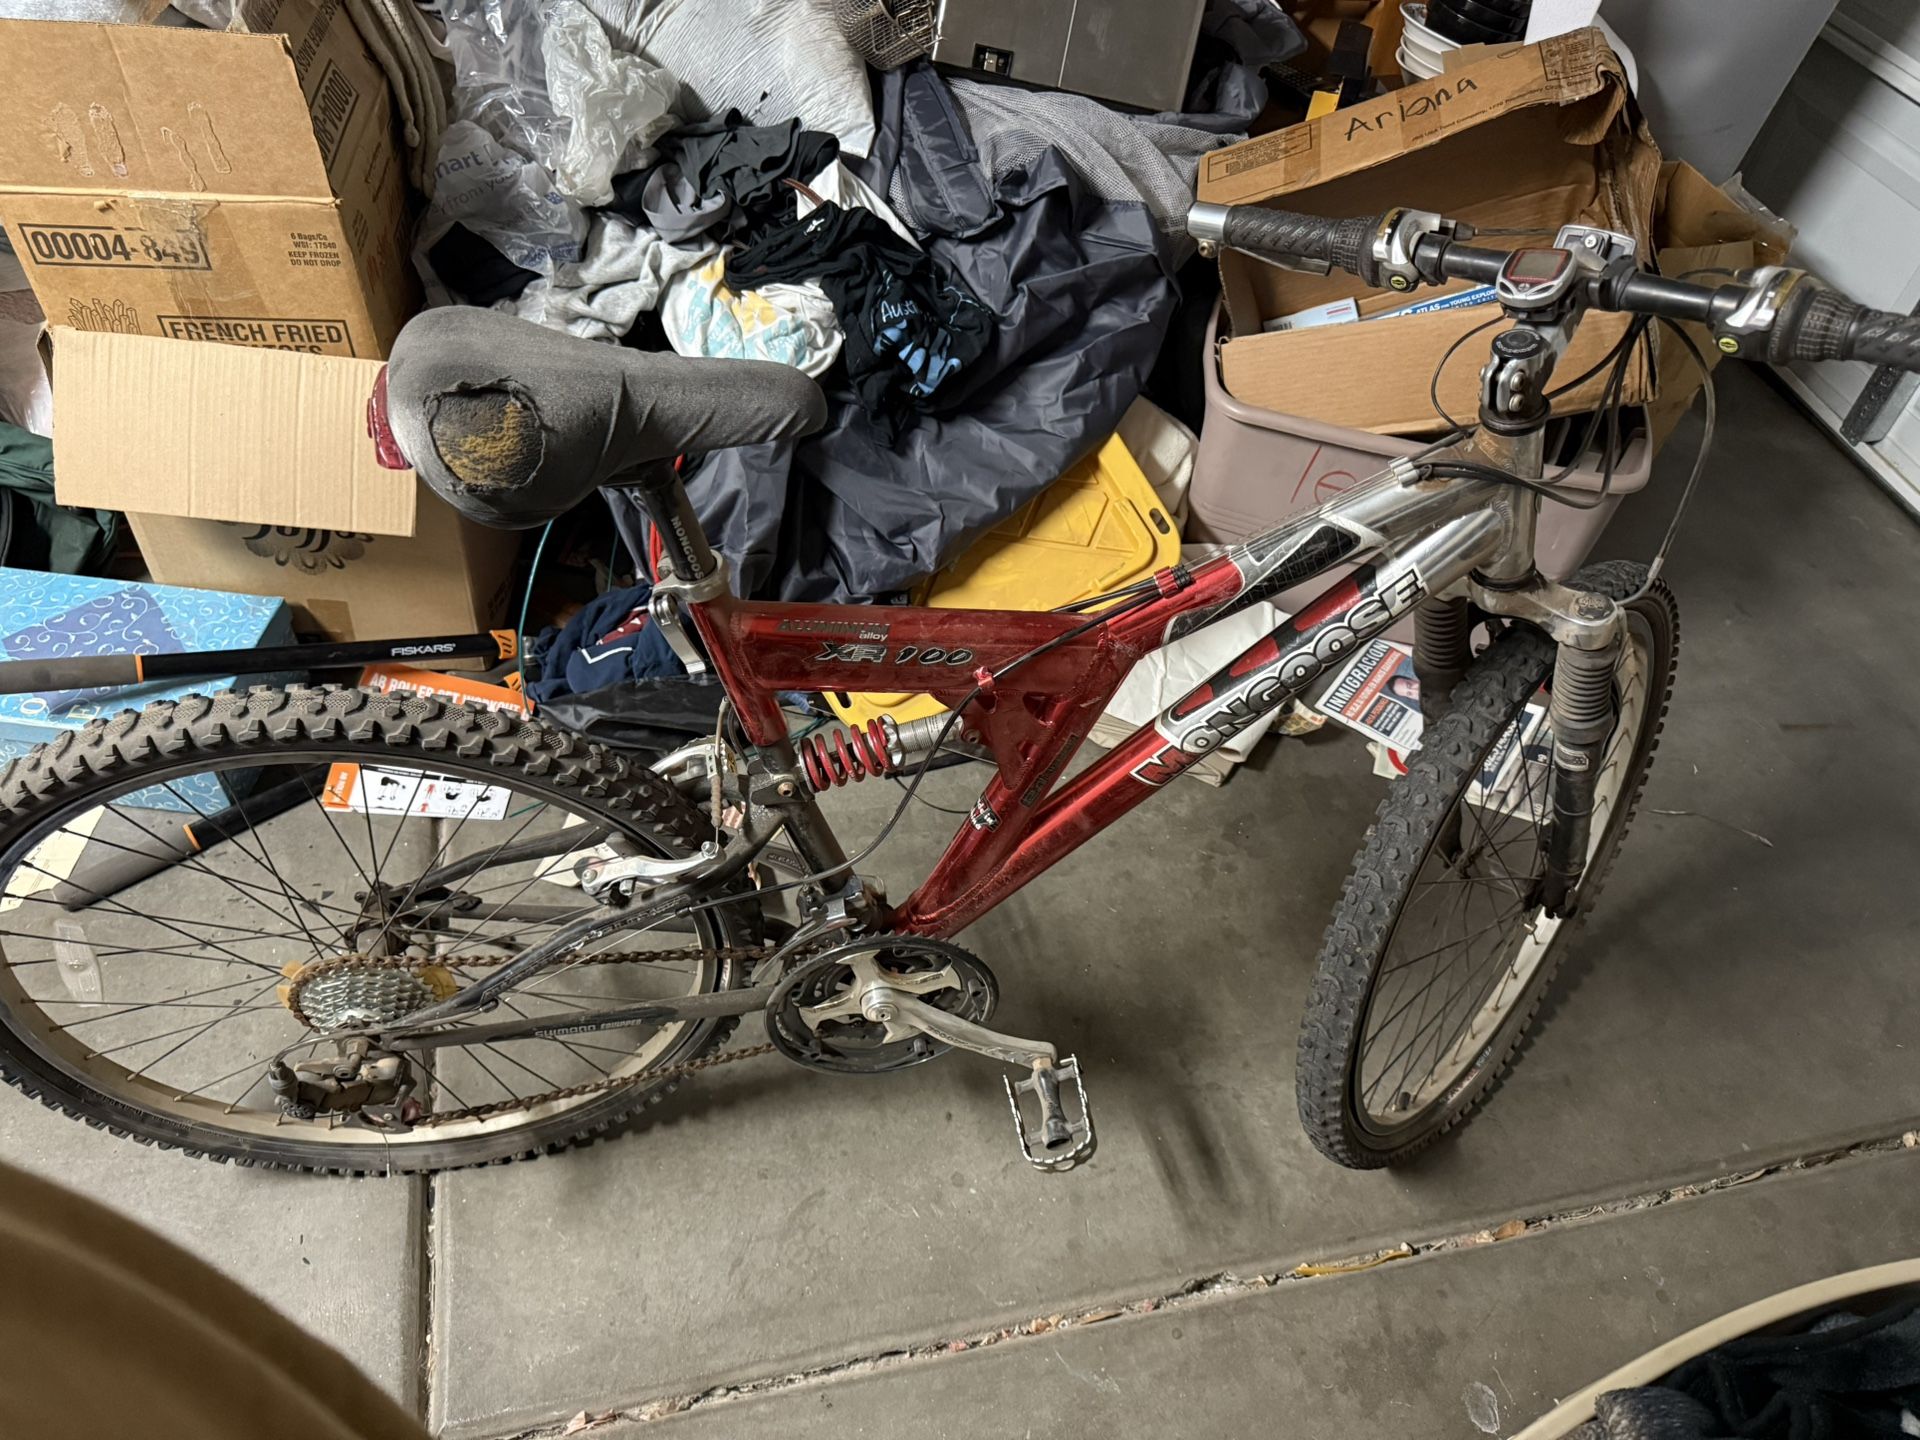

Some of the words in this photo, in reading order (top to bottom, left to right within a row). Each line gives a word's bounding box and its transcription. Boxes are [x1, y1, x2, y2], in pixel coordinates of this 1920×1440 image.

[1344, 77, 1478, 141] Ariana
[290, 232, 296, 241] 6
[288, 251, 307, 259] KEEP
[308, 251, 340, 260] FROZEN
[290, 259, 302, 267] DO
[303, 259, 319, 267] NOT
[319, 259, 342, 268] DROP
[1415, 303, 1441, 315] ATLAS
[1450, 295, 1471, 308] YOUNG
[168, 321, 268, 342] FRENCH
[272, 324, 344, 344] FRIED
[859, 630, 888, 642] alloy
[391, 644, 454, 657] FISKARS
[802, 641, 887, 663] XR
[895, 646, 974, 666] 100
[1130, 563, 1429, 786] MONGOOSE
